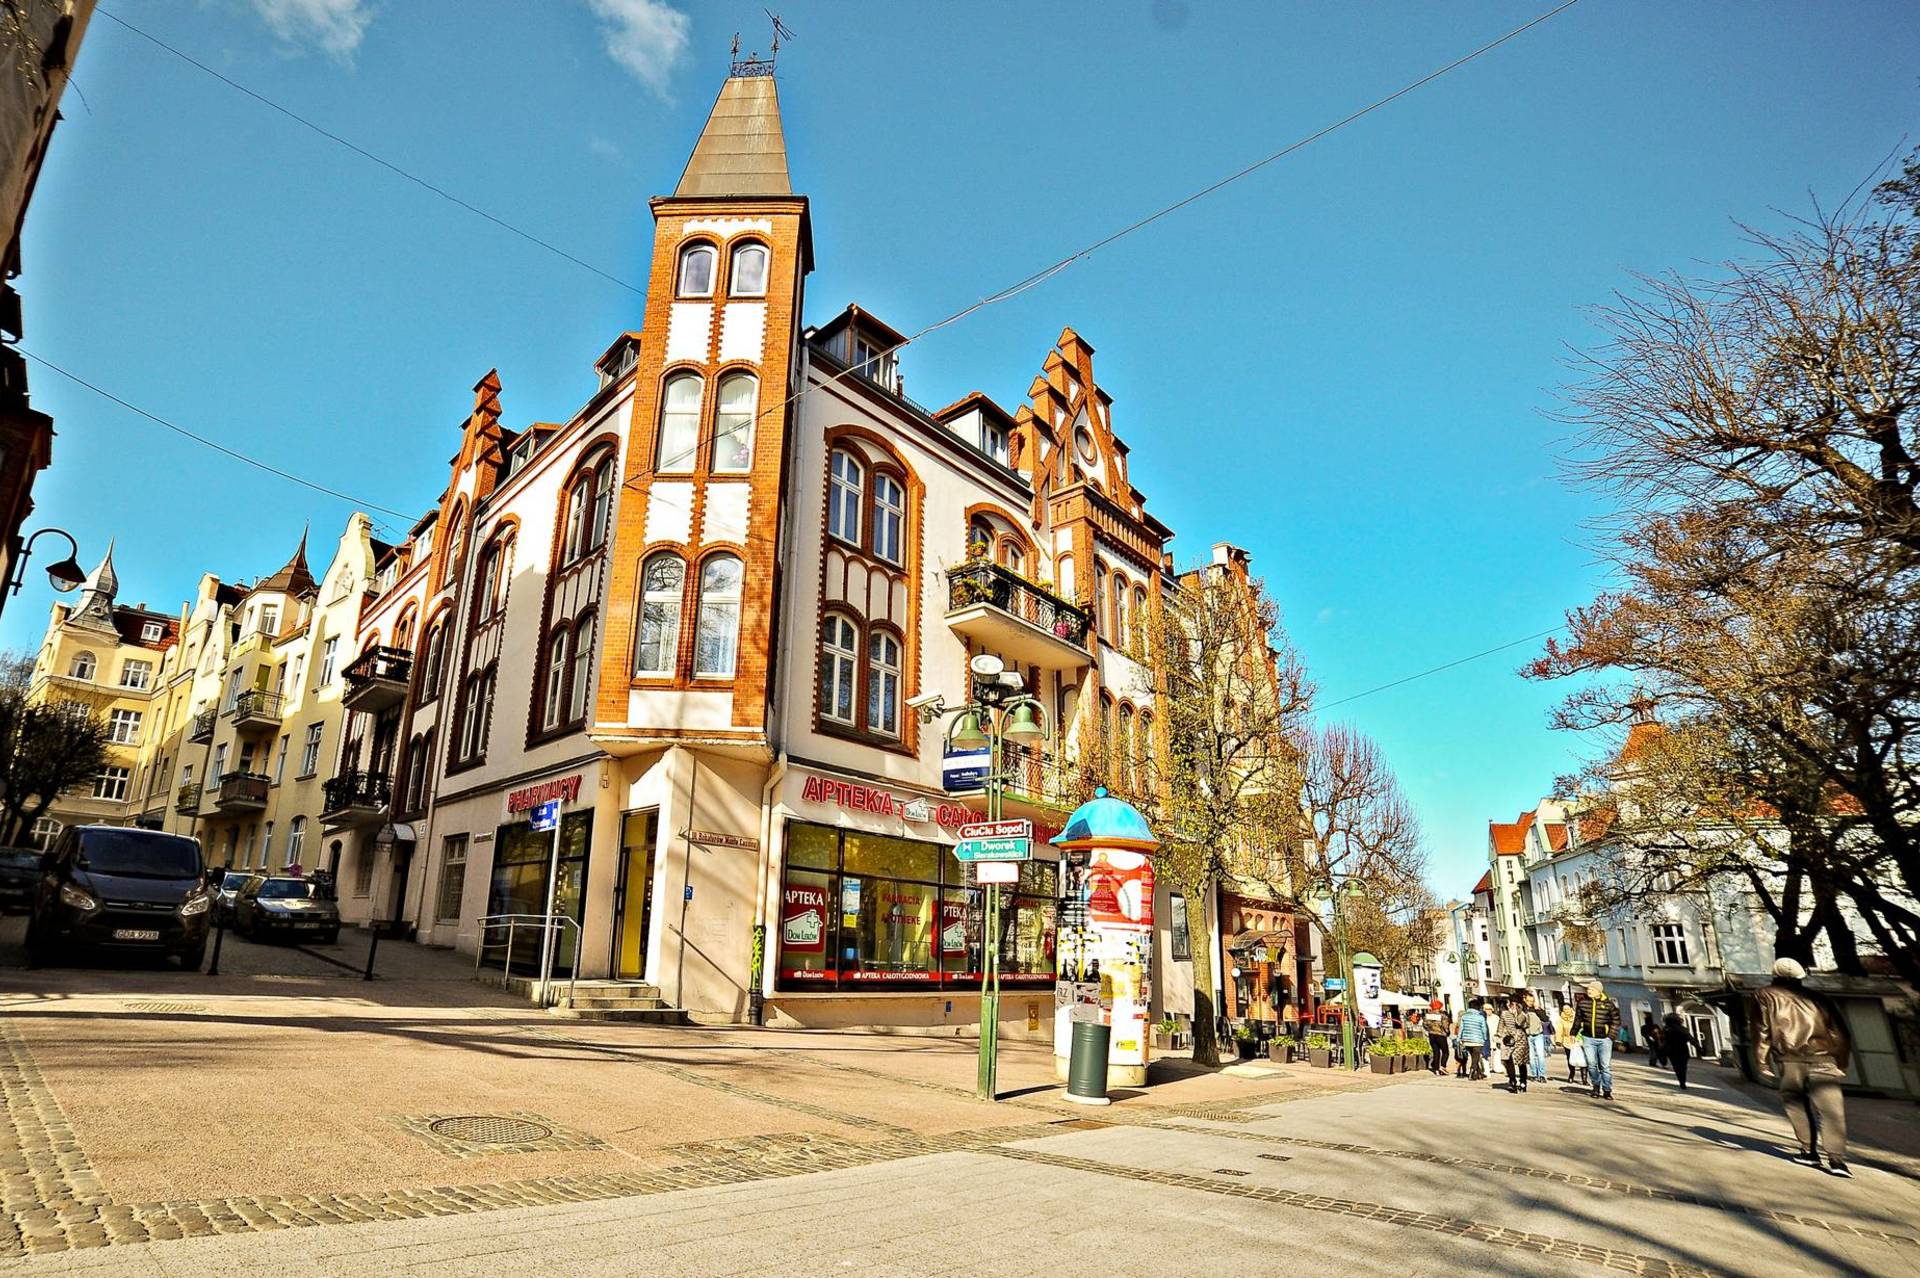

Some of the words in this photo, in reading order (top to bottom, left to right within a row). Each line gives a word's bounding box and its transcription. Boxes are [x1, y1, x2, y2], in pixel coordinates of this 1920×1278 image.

[507, 775, 582, 813] PHARMACY
[802, 775, 894, 816] APTEKA
[996, 823, 1023, 835] Sopot
[980, 840, 1016, 850] Dworek
[785, 890, 824, 906] APTEKA
